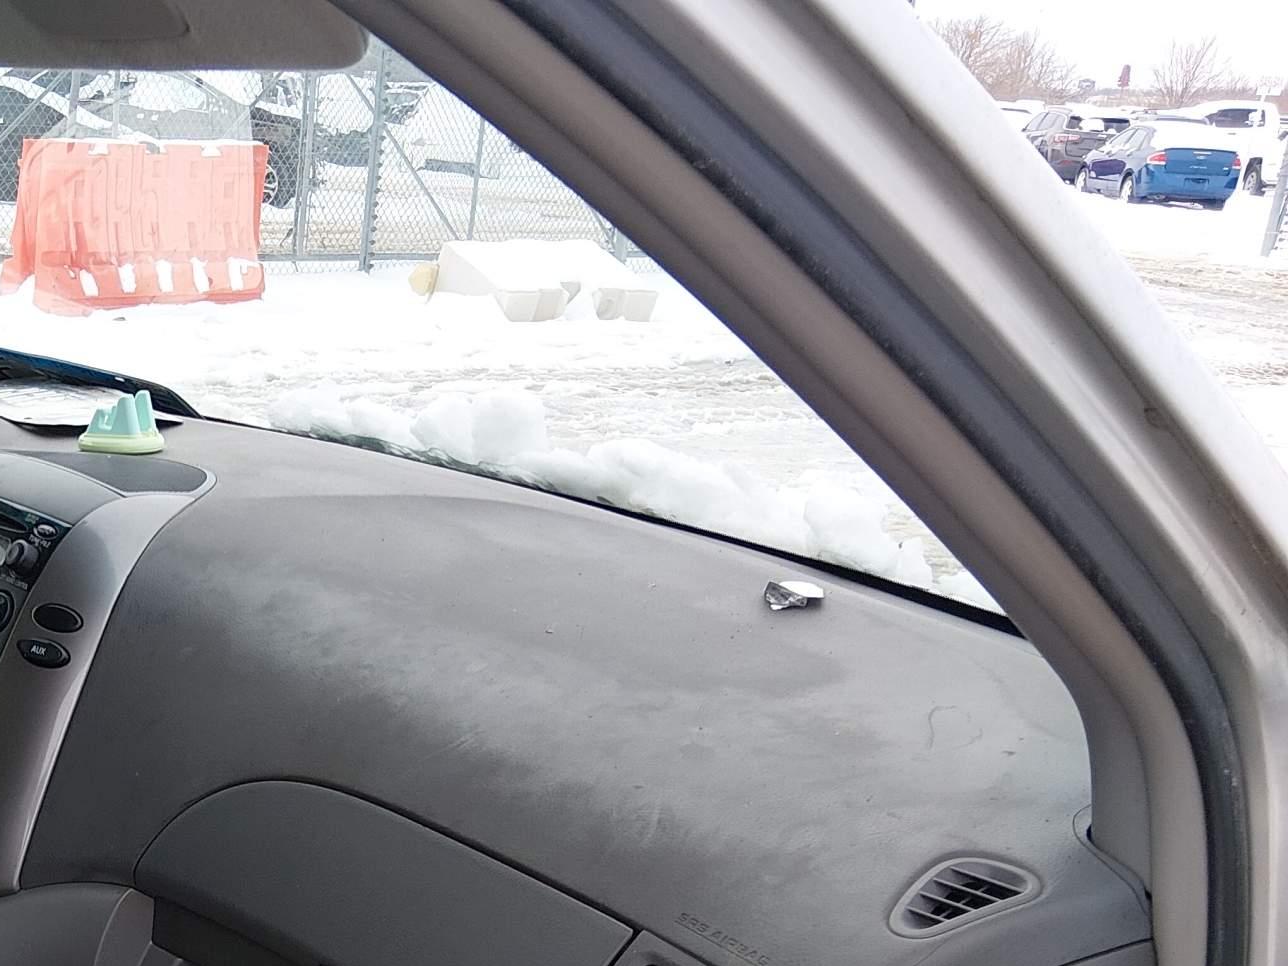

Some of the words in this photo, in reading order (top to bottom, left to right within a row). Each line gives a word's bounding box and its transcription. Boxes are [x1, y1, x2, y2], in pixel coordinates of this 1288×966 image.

[30, 644, 47, 656] AUX
[677, 912, 710, 933] SRS
[708, 930, 771, 966] AIRBAG
